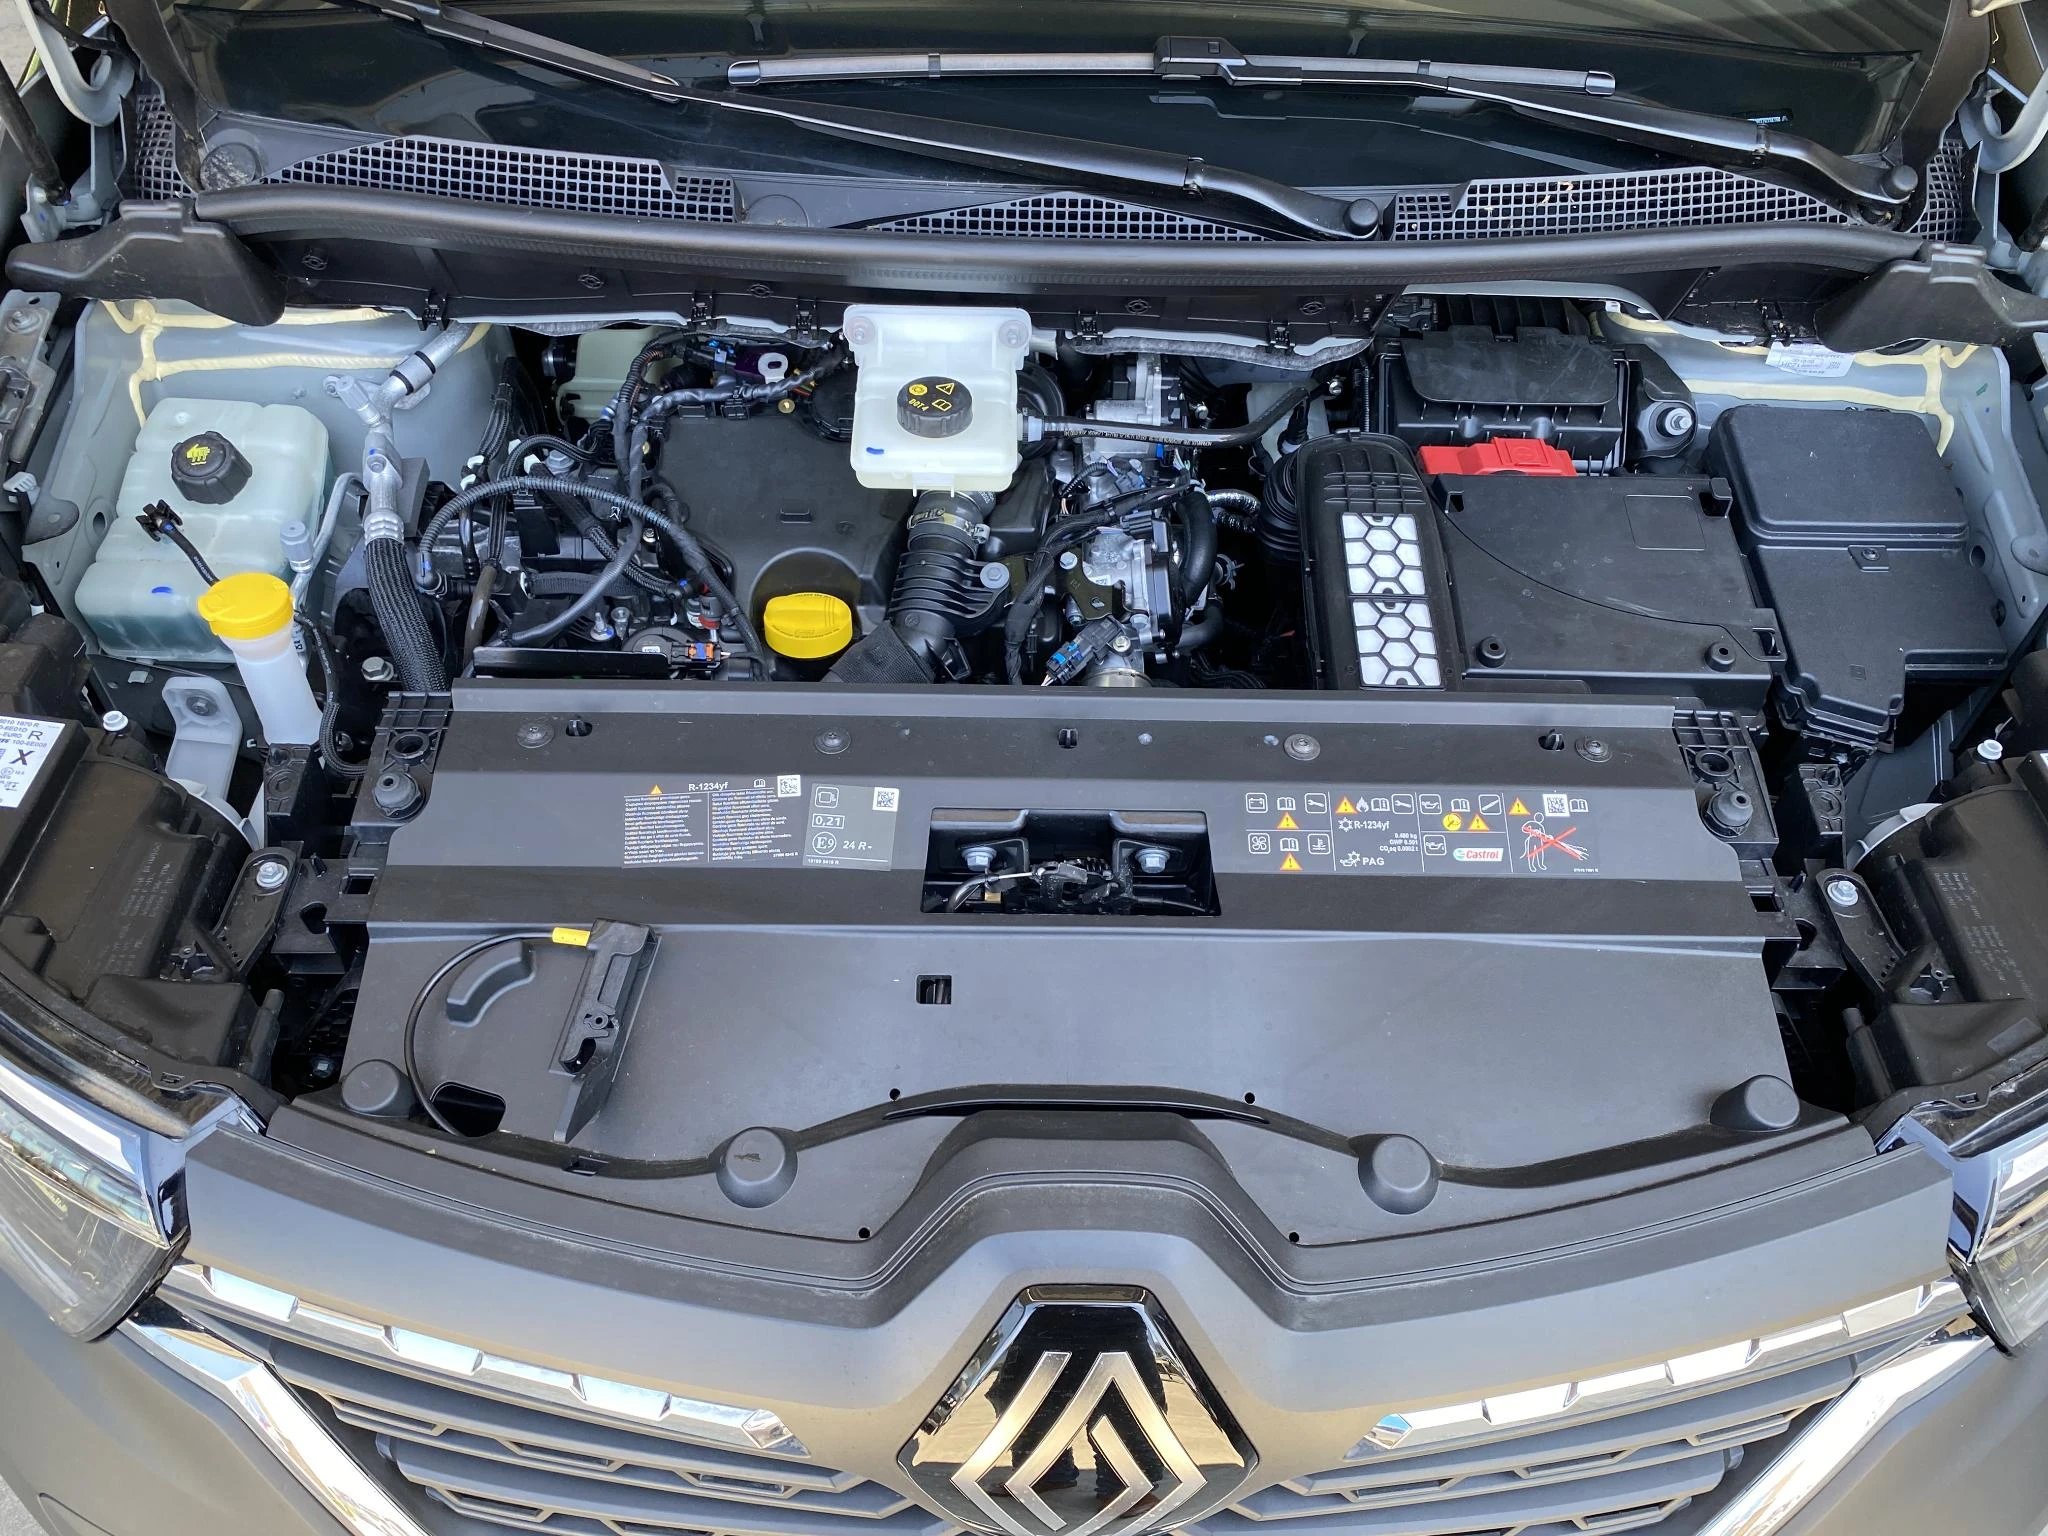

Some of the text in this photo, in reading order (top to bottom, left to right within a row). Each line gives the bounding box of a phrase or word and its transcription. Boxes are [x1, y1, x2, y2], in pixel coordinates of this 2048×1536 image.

[28, 730, 43, 741] R
[9, 748, 35, 766] X
[688, 781, 729, 791] R-1234yf
[815, 815, 841, 827] 0,21
[1353, 820, 1390, 831] R-1234yf
[816, 836, 835, 850] E9
[843, 840, 856, 850] 24
[1466, 849, 1499, 860] Castrol
[1362, 857, 1385, 866] PAG
